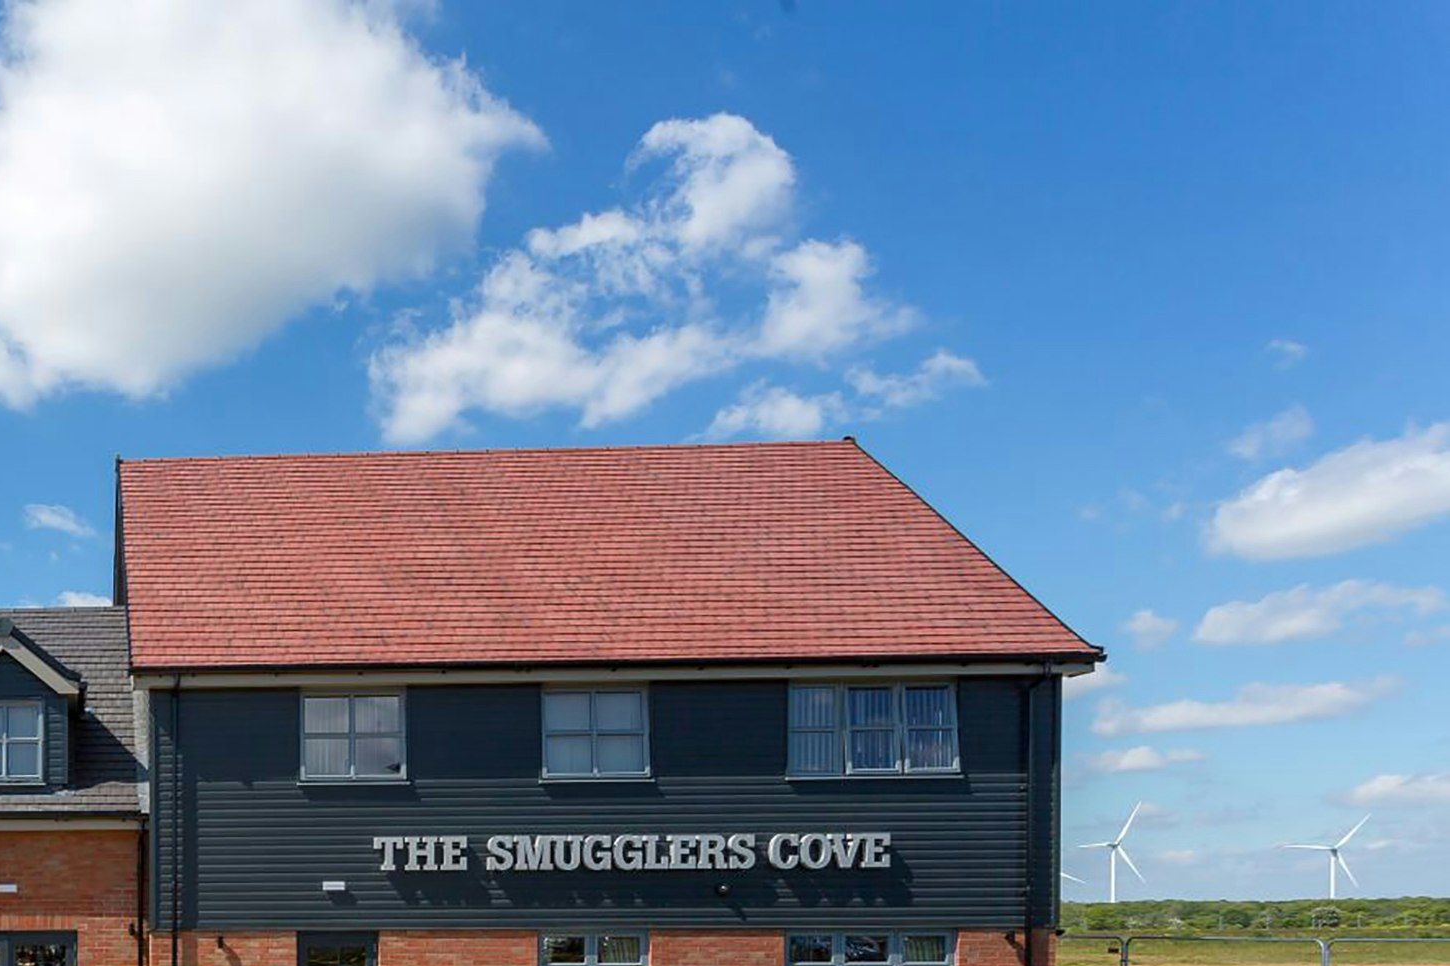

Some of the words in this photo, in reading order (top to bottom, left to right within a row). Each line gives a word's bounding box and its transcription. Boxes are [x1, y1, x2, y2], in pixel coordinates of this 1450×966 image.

[373, 835, 468, 871] THE
[486, 833, 756, 871] SMUGGLERS
[768, 833, 892, 869] COVE
